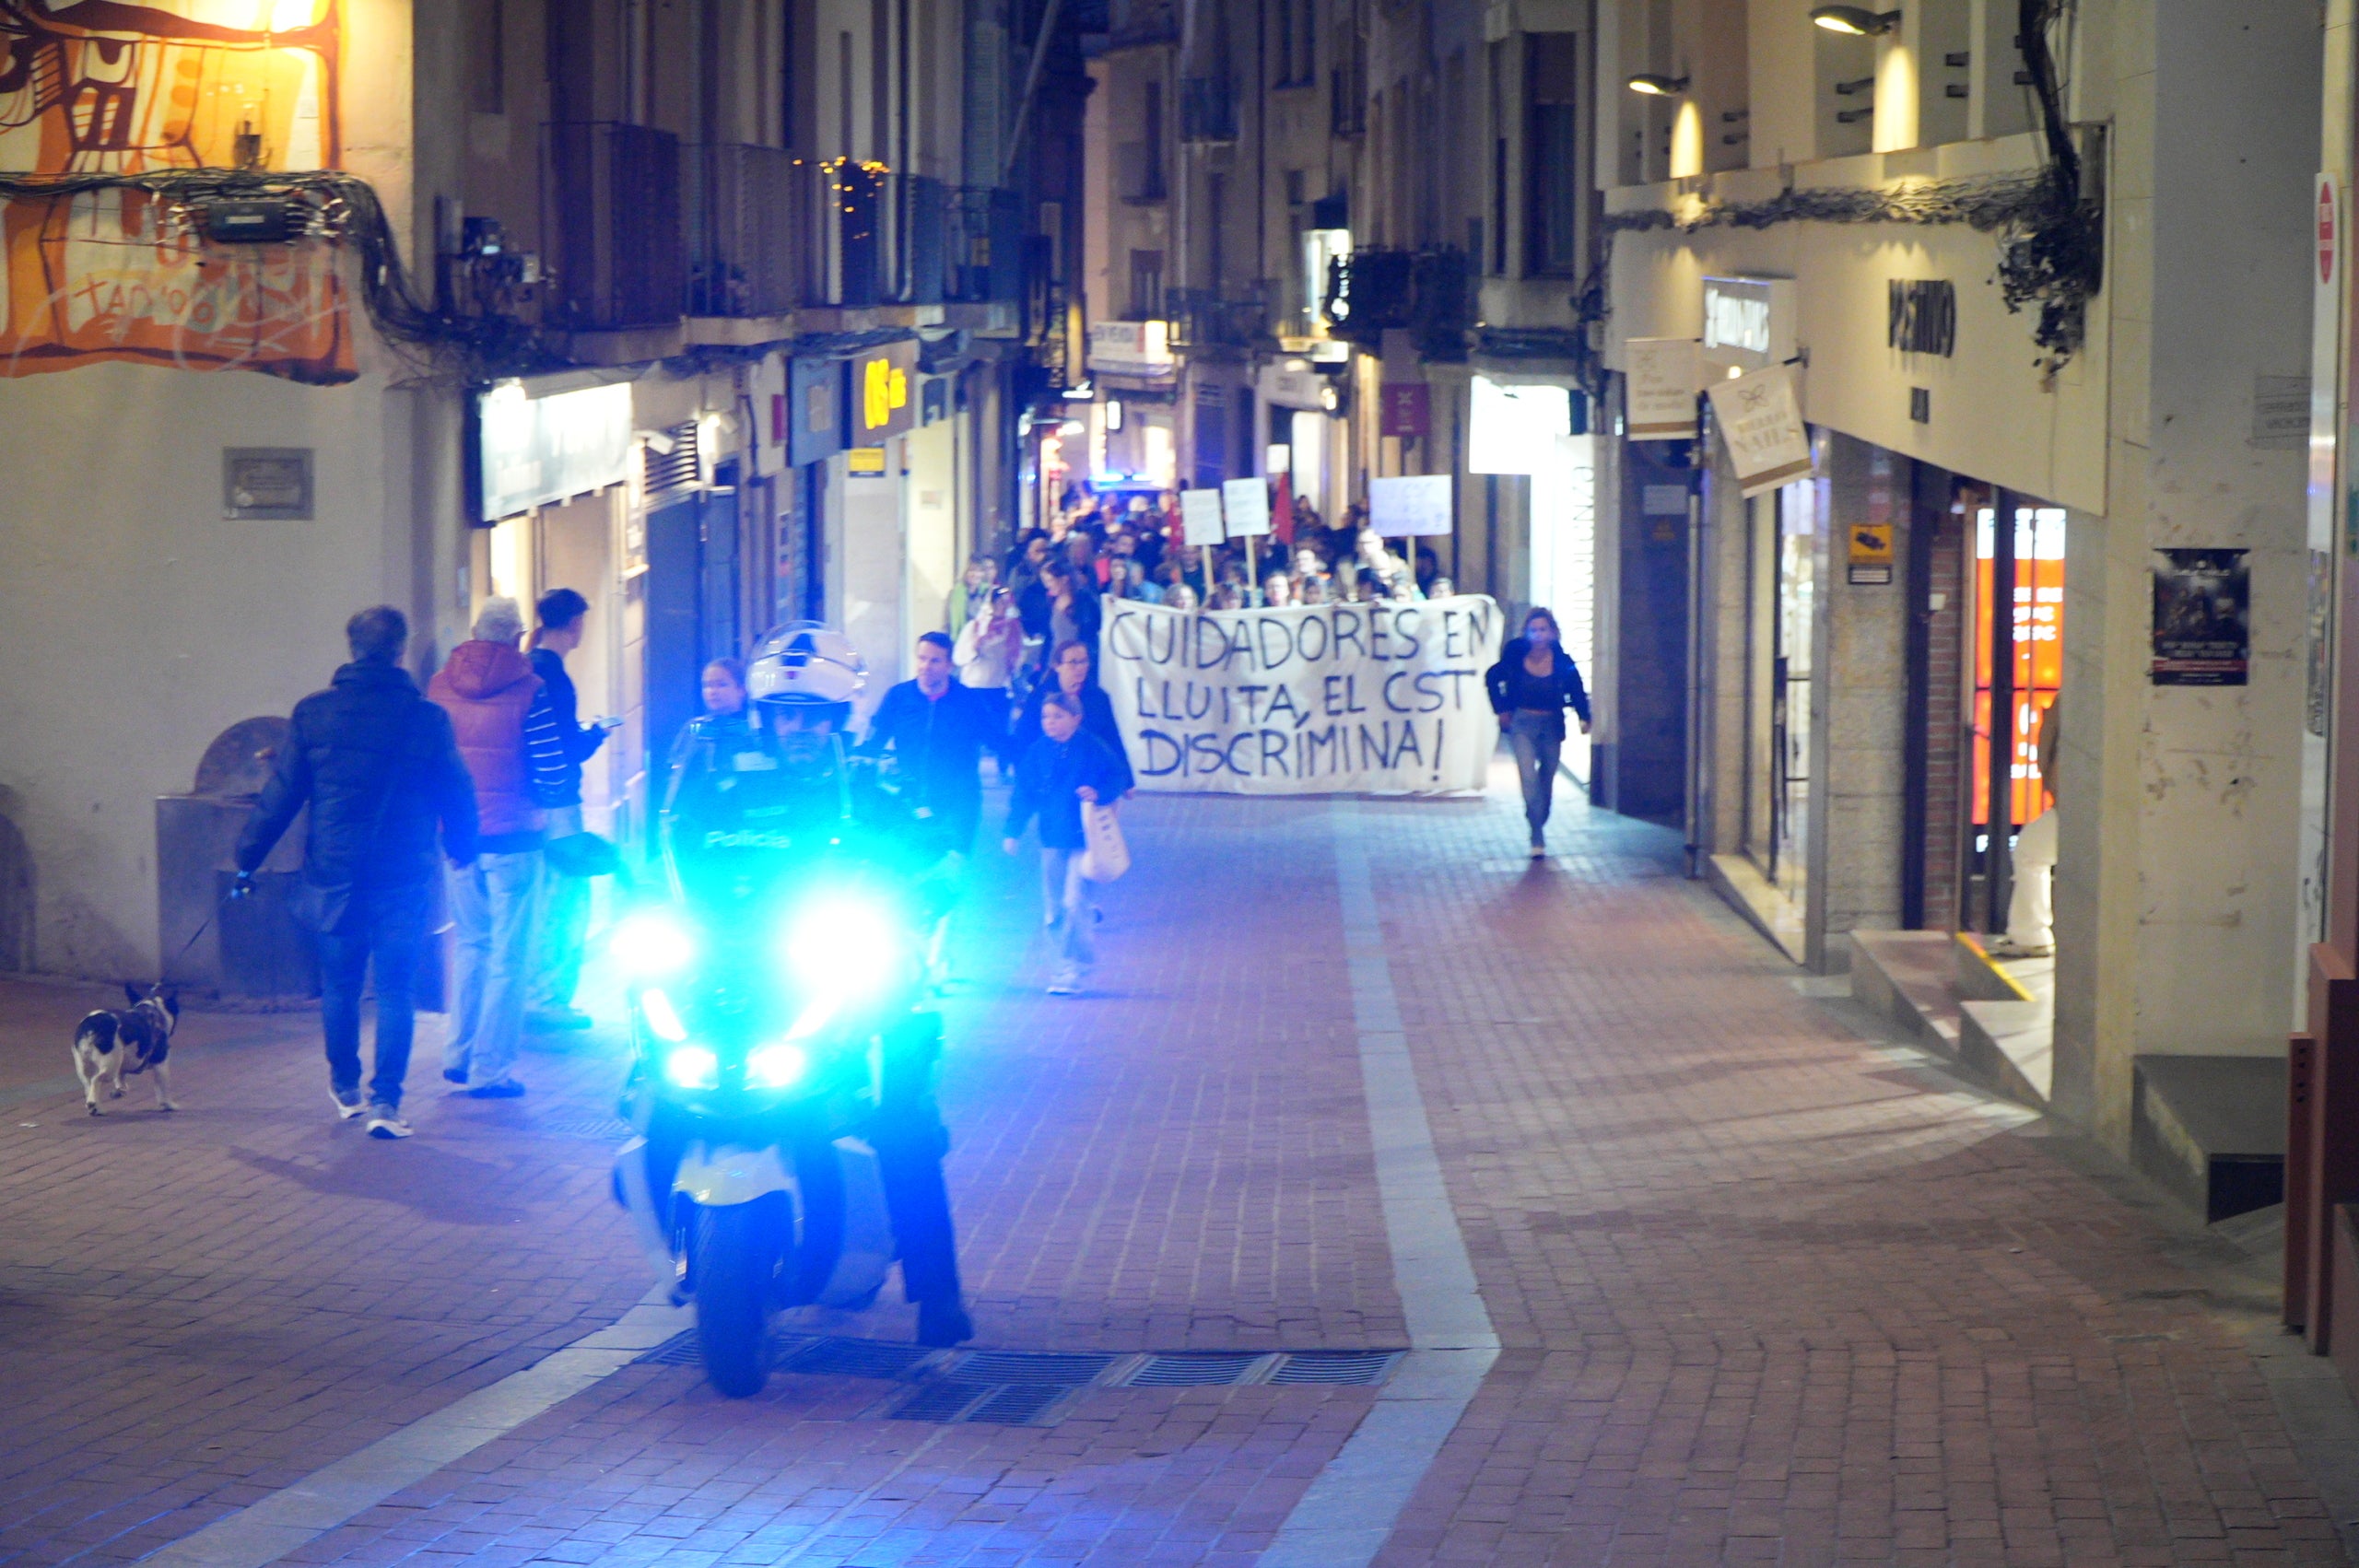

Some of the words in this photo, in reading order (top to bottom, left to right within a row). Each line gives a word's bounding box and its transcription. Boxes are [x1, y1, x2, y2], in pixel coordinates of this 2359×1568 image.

[1109, 607, 1420, 671] CUIDADORES
[1443, 602, 1490, 658] EN
[1137, 676, 1311, 729] LLUITA,
[1323, 674, 1367, 716] EL
[1384, 669, 1477, 713] CST
[1138, 719, 1444, 781] DISCRIMINA!
